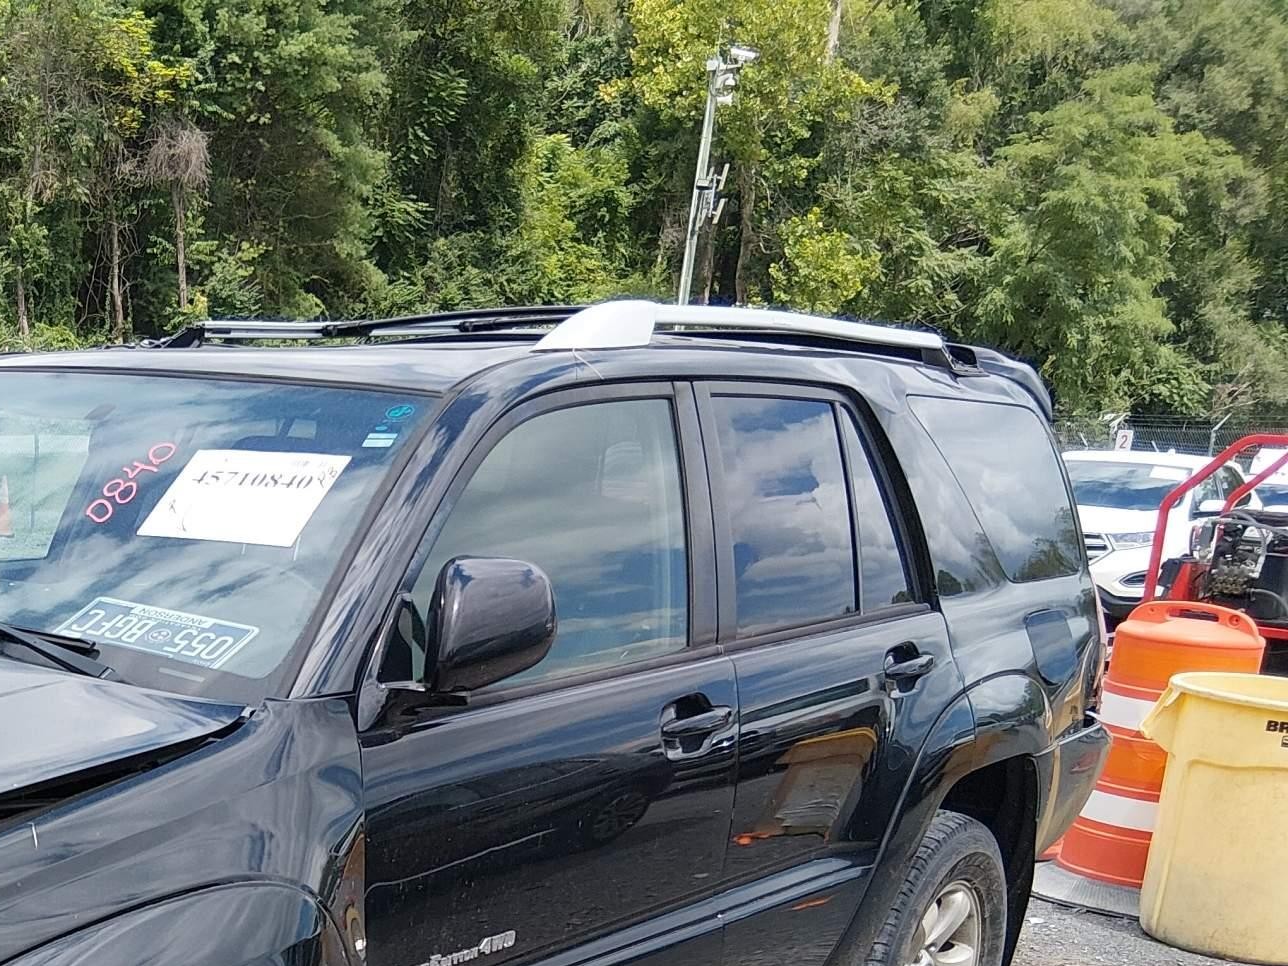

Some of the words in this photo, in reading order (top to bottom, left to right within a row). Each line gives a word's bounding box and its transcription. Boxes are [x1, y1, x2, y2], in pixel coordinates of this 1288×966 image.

[86, 442, 176, 523] 0840
[192, 470, 314, 489] 45710840
[140, 606, 207, 626] ANDERSON
